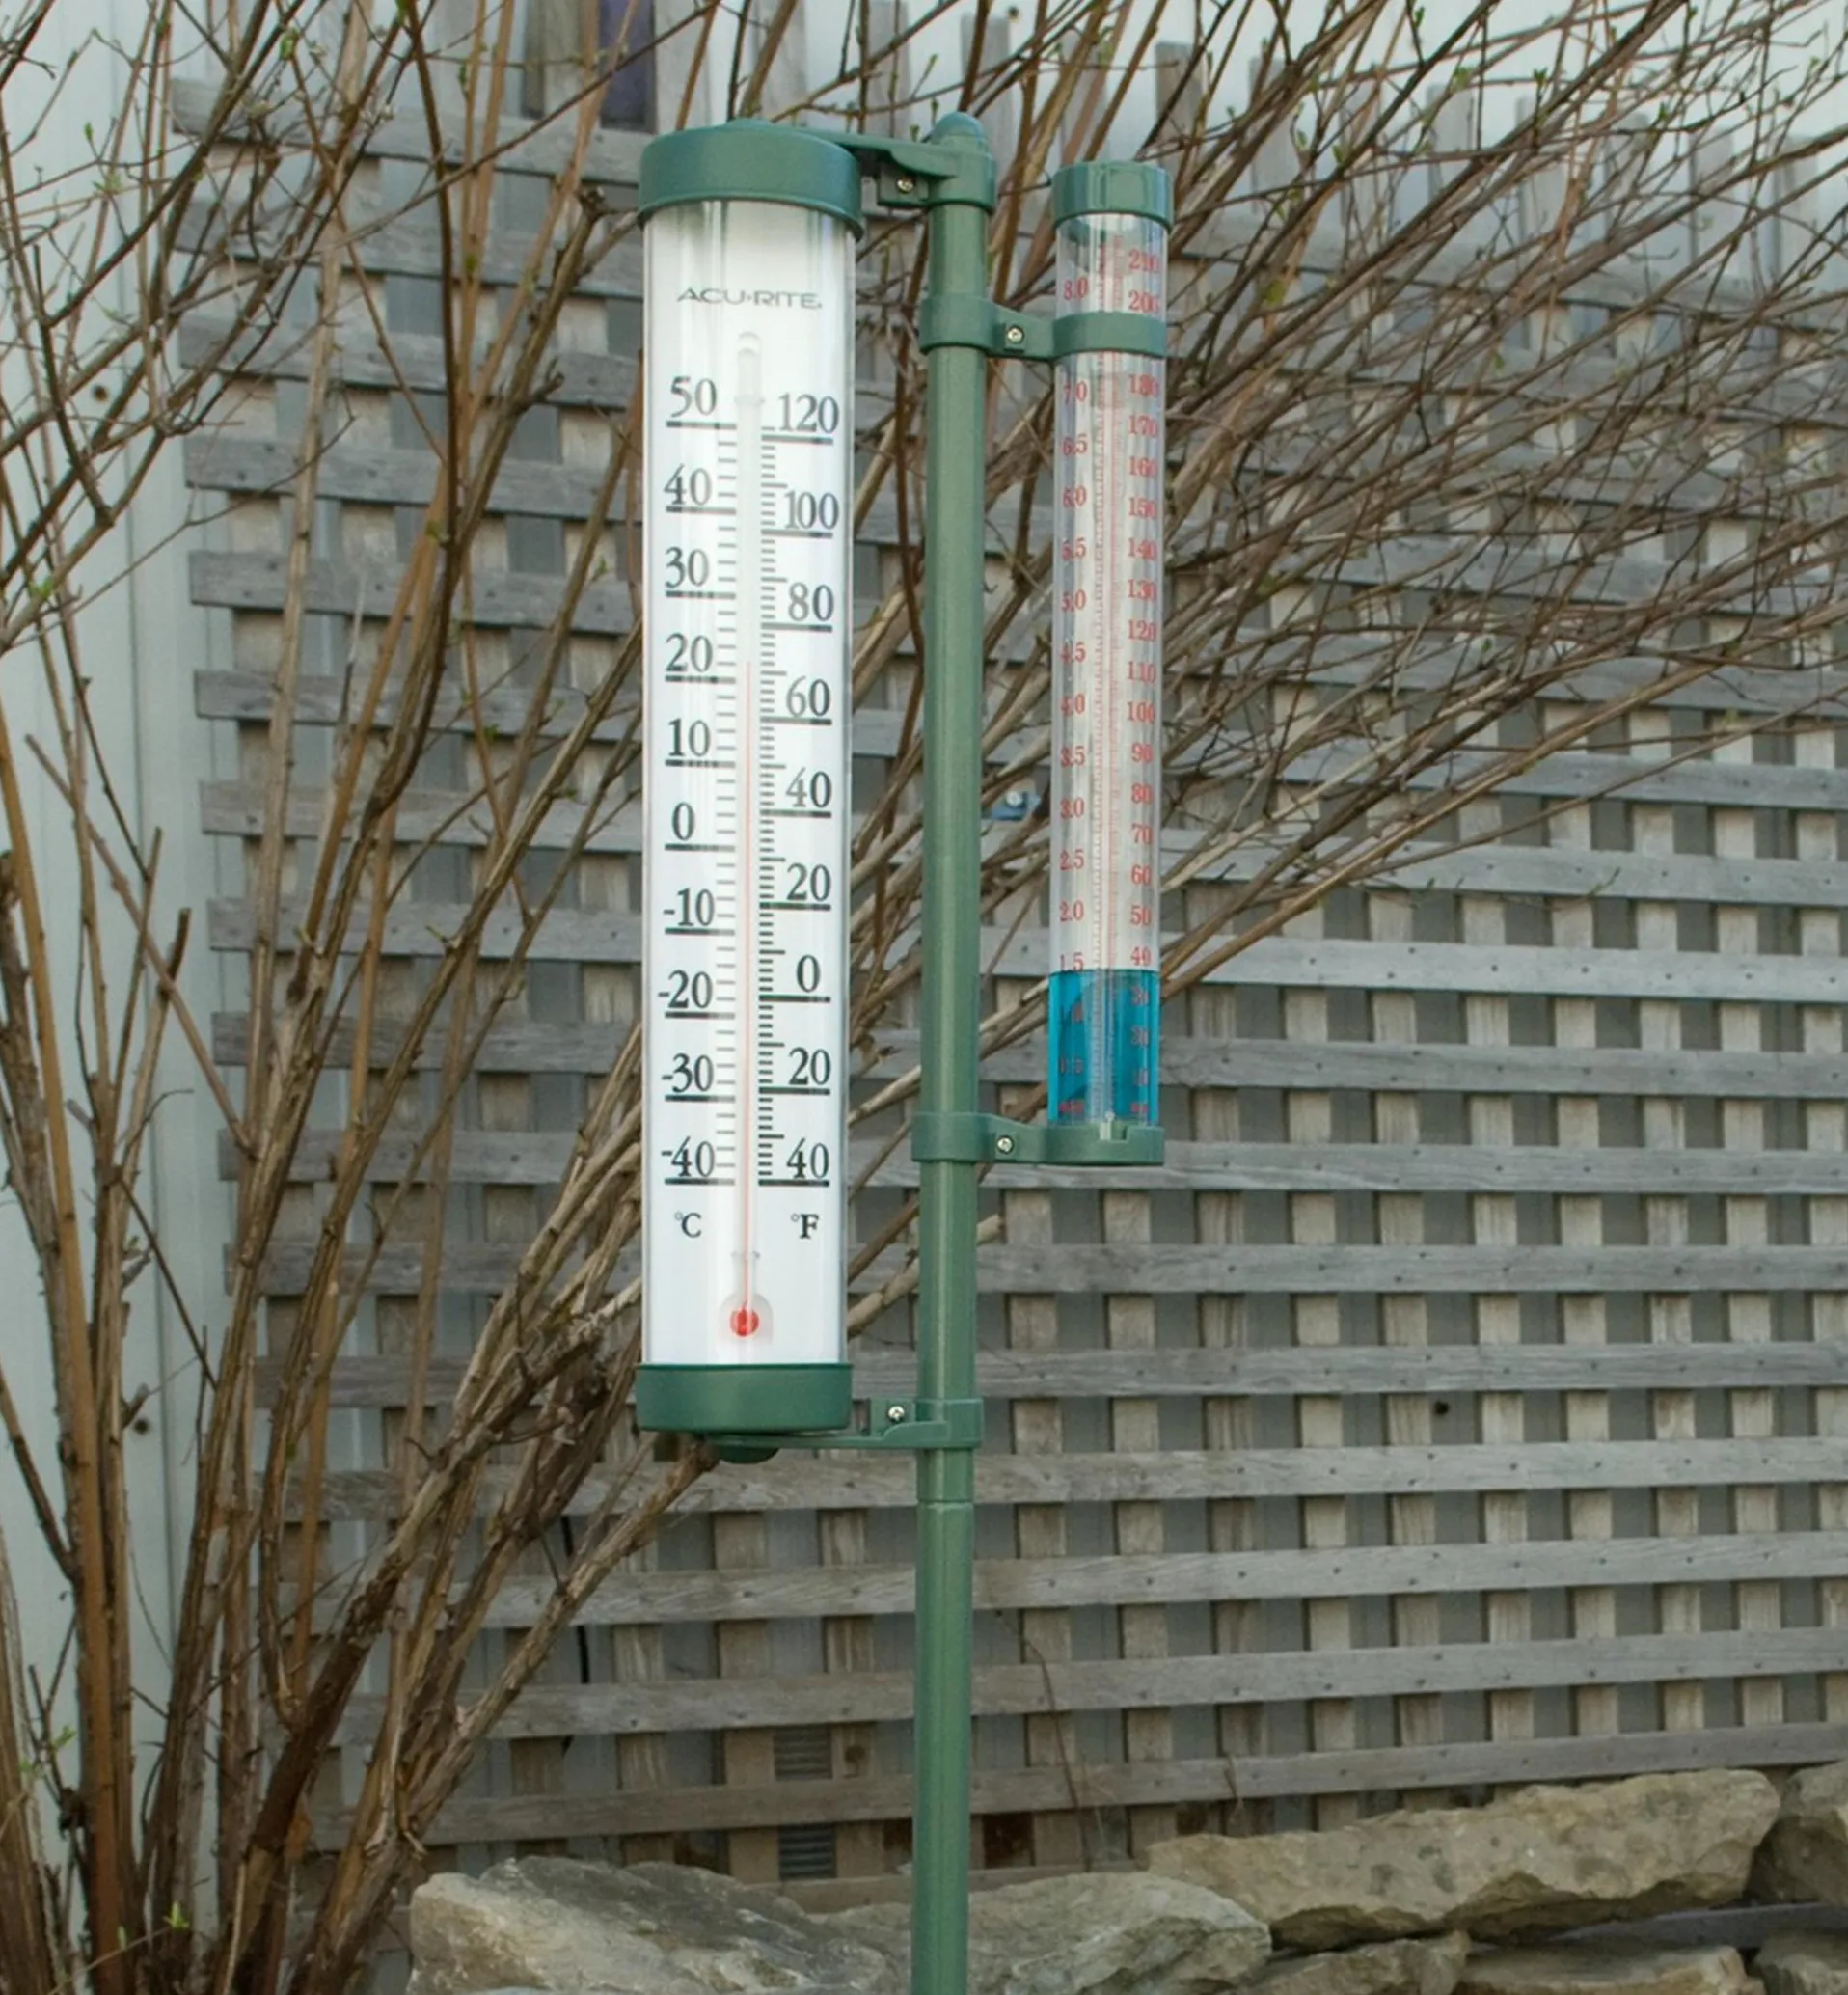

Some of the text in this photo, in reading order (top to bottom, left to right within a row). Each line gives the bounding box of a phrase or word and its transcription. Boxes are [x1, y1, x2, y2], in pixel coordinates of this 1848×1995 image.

[670, 376, 717, 417] 50
[778, 394, 839, 433] 120
[664, 463, 712, 506] 40
[784, 491, 839, 530] 100
[666, 546, 709, 588] 30
[788, 582, 834, 621] 80
[666, 633, 713, 672] 20
[786, 676, 830, 717] 60
[668, 718, 711, 757] 10
[786, 768, 832, 808] 40
[671, 802, 695, 841] 0
[786, 862, 831, 901] 20
[664, 888, 714, 927] -10
[1130, 905, 1152, 926] 50
[797, 954, 820, 993] 0
[1130, 946, 1152, 967] 40
[658, 970, 713, 1009] -20
[662, 1052, 714, 1093] -30
[789, 1047, 831, 1086] 20
[661, 1135, 715, 1178] -40
[787, 1137, 829, 1179] 40
